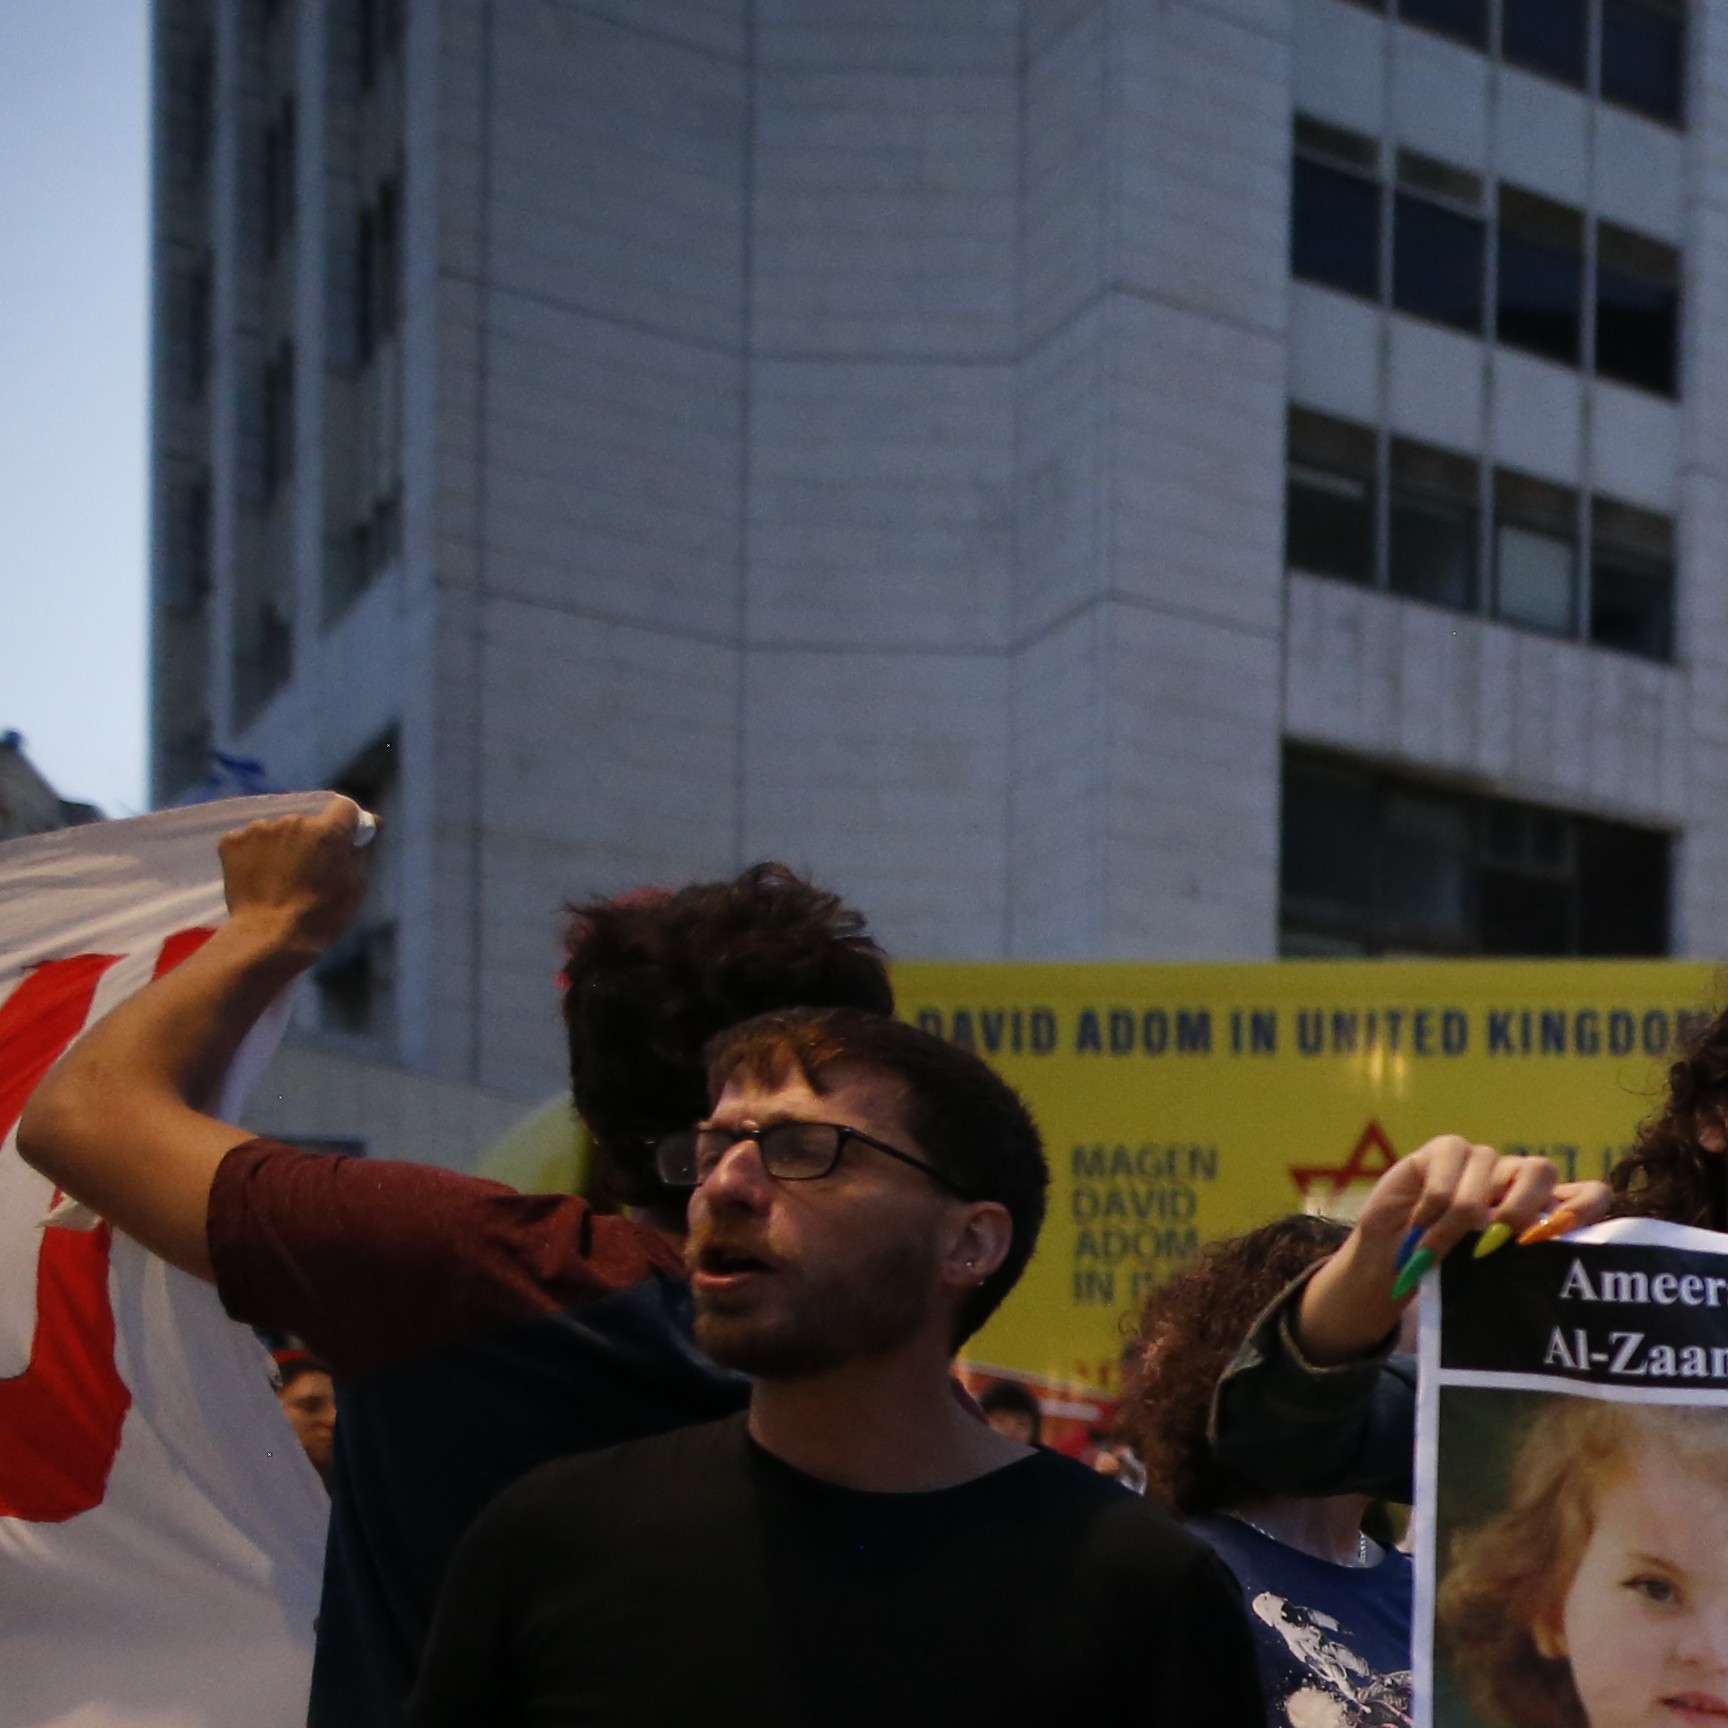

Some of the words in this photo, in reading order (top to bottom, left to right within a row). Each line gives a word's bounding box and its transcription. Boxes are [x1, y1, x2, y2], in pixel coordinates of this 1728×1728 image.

[1077, 1008, 1213, 1055] ADOM
[1230, 1008, 1277, 1055] IN
[1298, 1008, 1469, 1056] UNITED
[1071, 1144, 1218, 1181] MAGEN
[1072, 1187, 1196, 1222] DAVID
[1075, 1228, 1199, 1260] ADOM
[1073, 1270, 1115, 1304] IN
